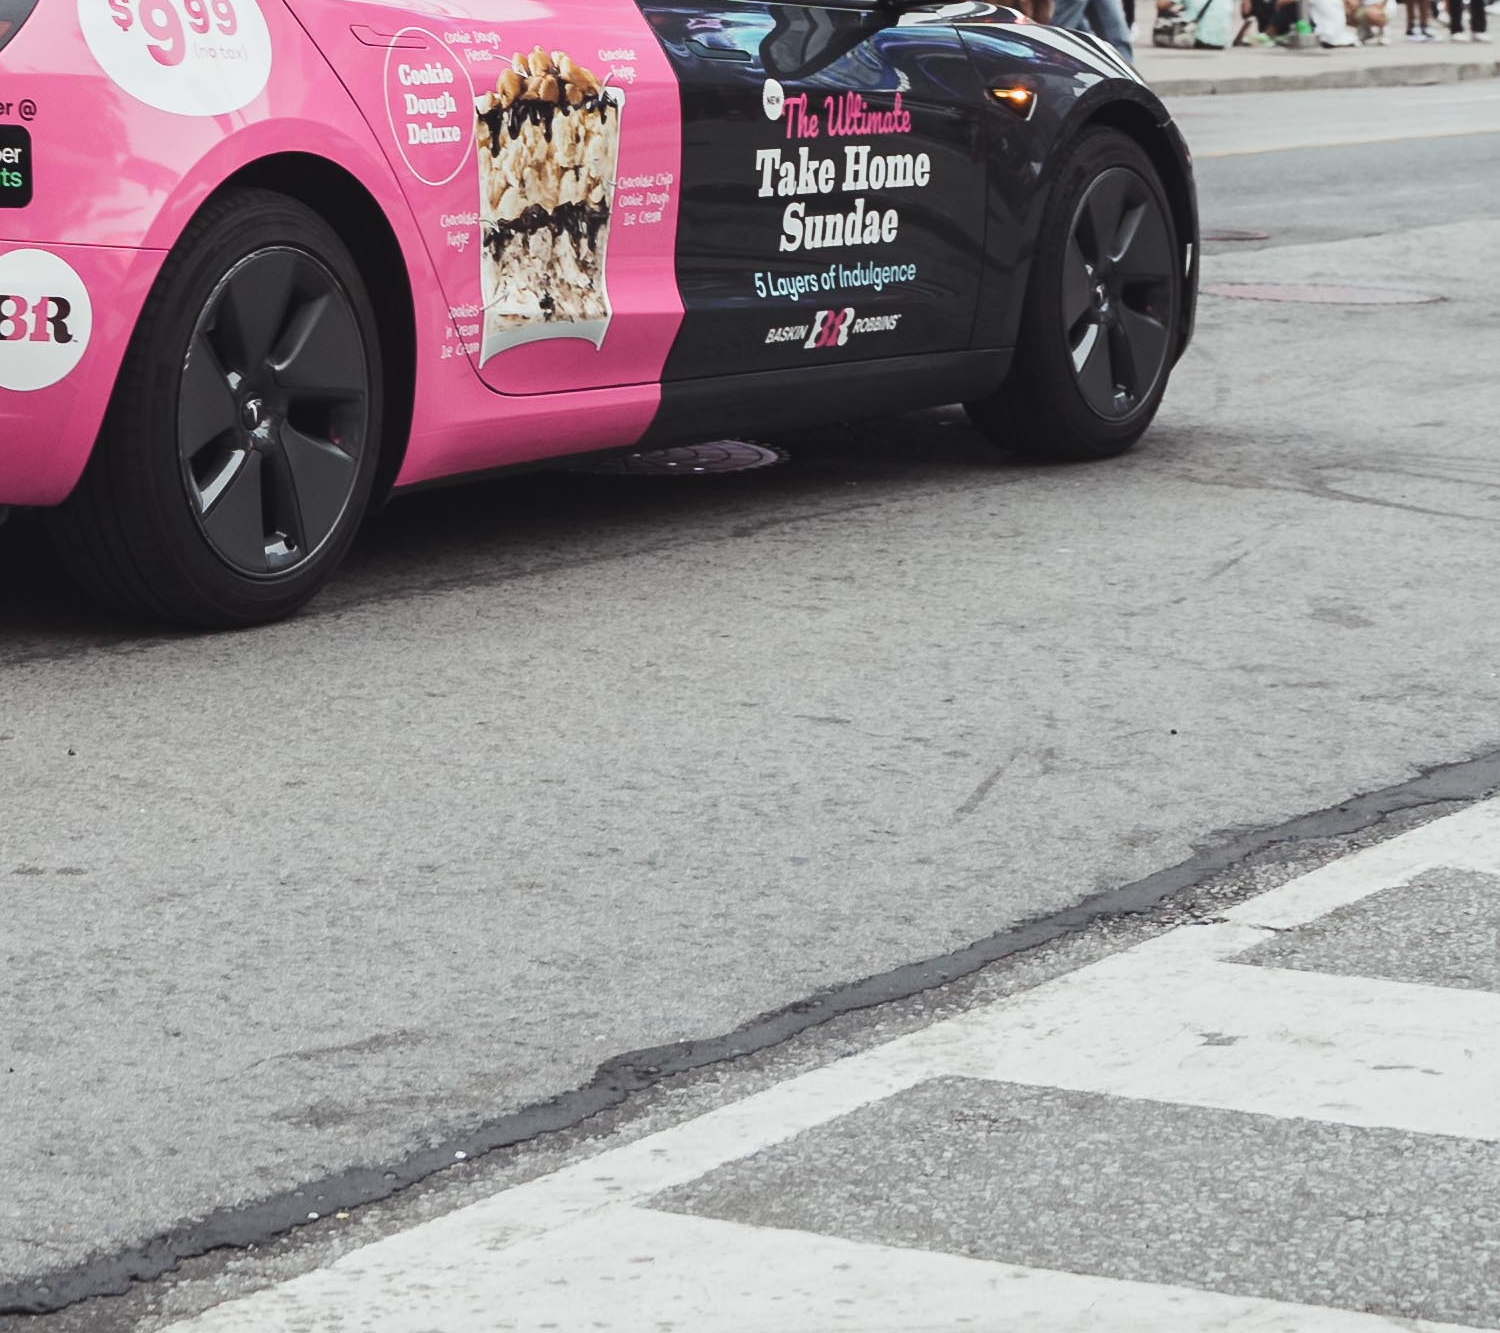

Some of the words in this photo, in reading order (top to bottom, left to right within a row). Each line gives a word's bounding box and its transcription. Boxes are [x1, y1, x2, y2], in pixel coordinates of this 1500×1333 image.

[398, 63, 454, 86] Cookie
[18, 98, 38, 121] @
[404, 92, 457, 118] Dough
[767, 95, 781, 105] NEW
[782, 92, 819, 139] The
[824, 90, 912, 137] Ultimate
[408, 122, 462, 145] Deluxe
[755, 147, 836, 197] Take
[842, 145, 931, 191] Home
[779, 198, 899, 252] Sundae
[754, 272, 767, 298] 5
[768, 271, 819, 301] Layers
[821, 264, 836, 290] of
[839, 261, 917, 291] Indulgence
[765, 325, 809, 343] BASKIN
[803, 307, 855, 349] BR
[852, 314, 899, 333] ROBBINS
